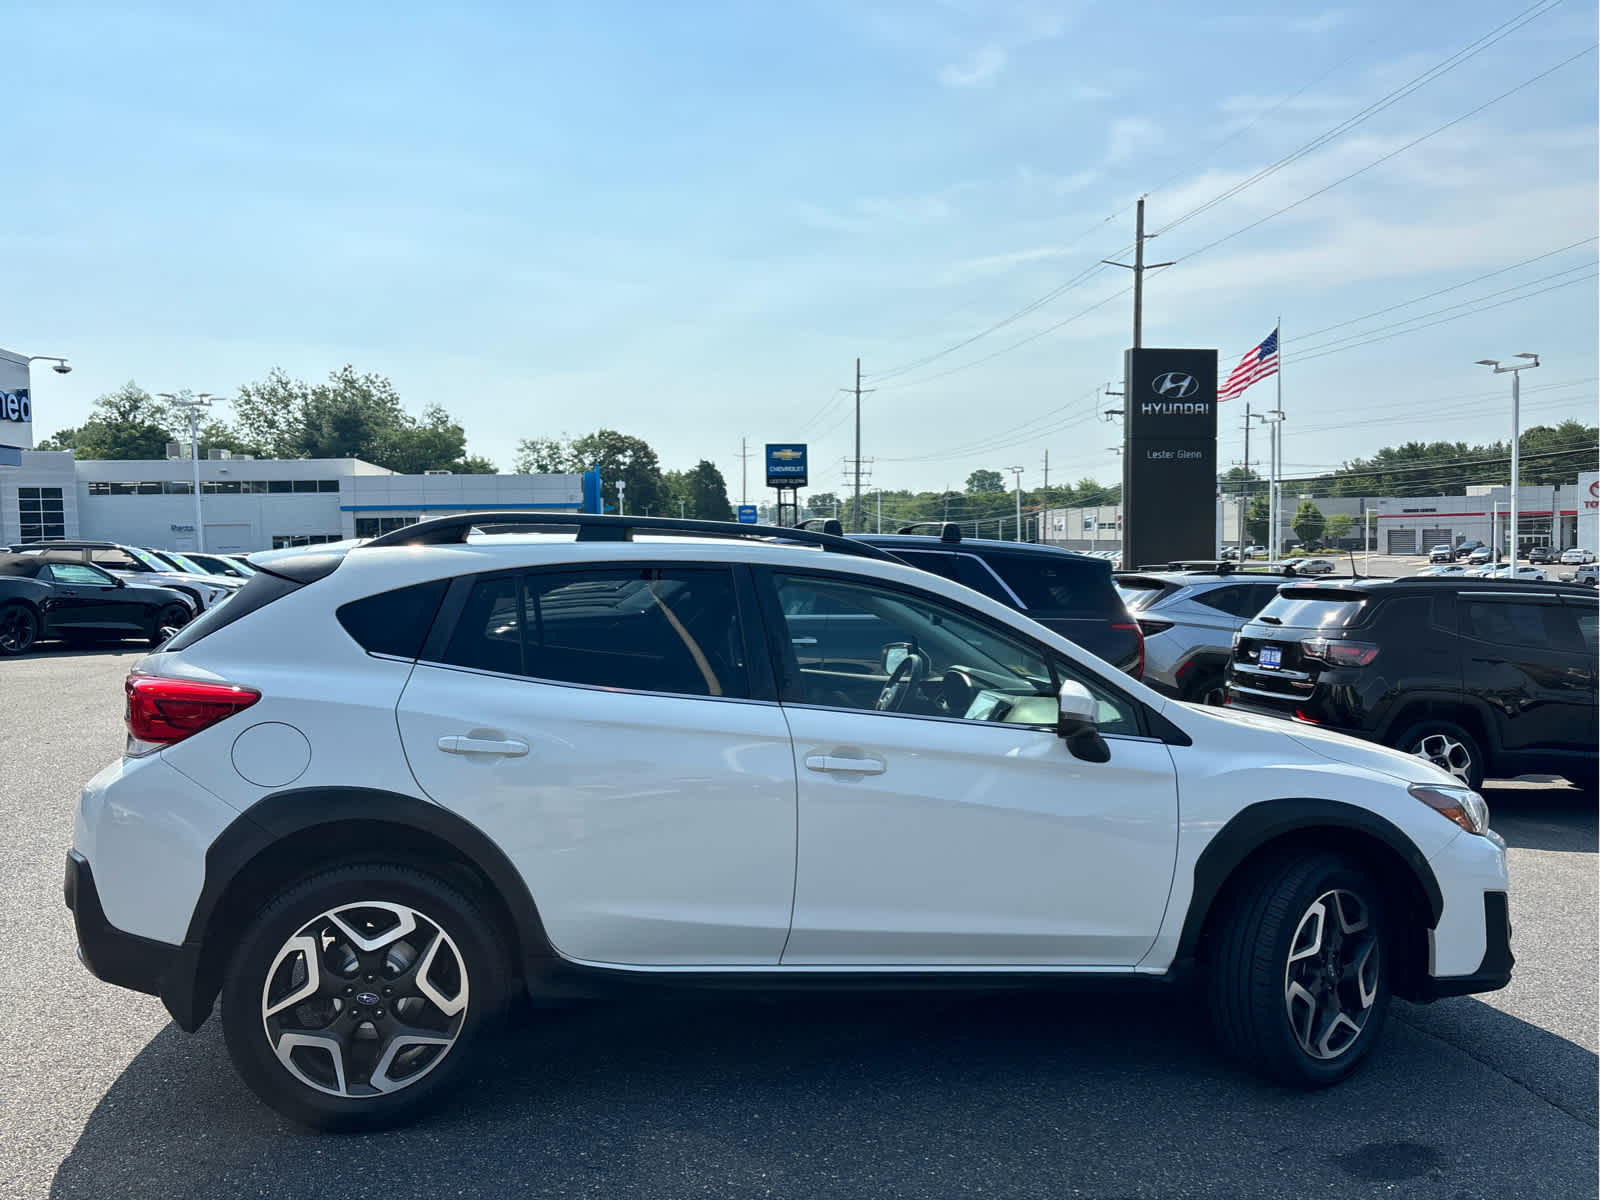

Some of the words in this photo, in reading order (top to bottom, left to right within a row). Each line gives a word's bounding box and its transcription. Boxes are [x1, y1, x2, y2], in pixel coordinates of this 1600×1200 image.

[1141, 402, 1209, 415] HYUNDAI
[1147, 449, 1175, 459] Lester
[1177, 449, 1202, 459] Glenn
